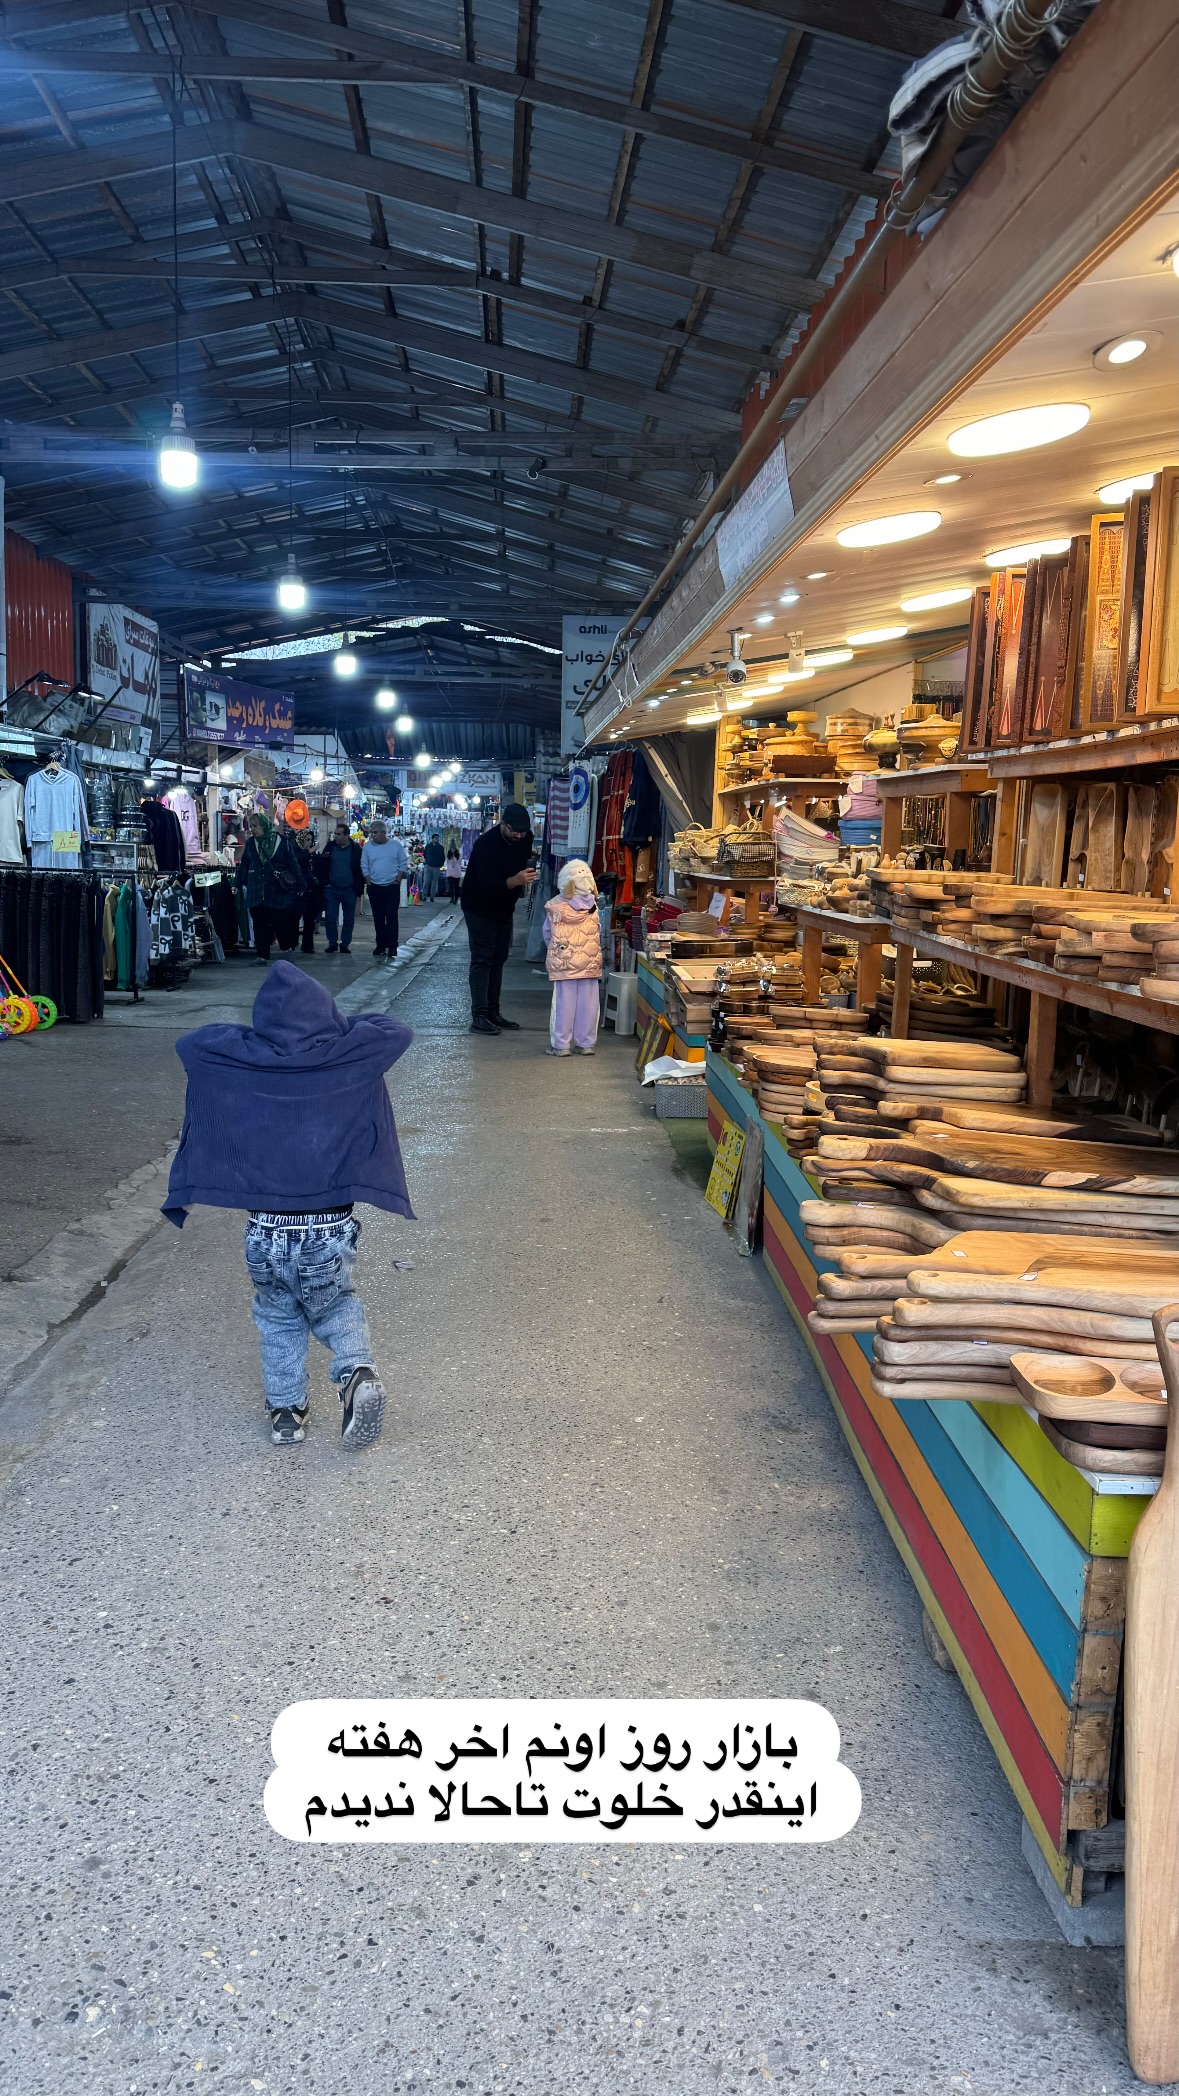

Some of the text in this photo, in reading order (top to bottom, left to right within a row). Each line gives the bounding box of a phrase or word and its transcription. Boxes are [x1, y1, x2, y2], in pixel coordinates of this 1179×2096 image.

[579, 624, 607, 634] ashli
[565, 650, 605, 666] خواب
[227, 695, 293, 737] عینک و کلاه وحید
